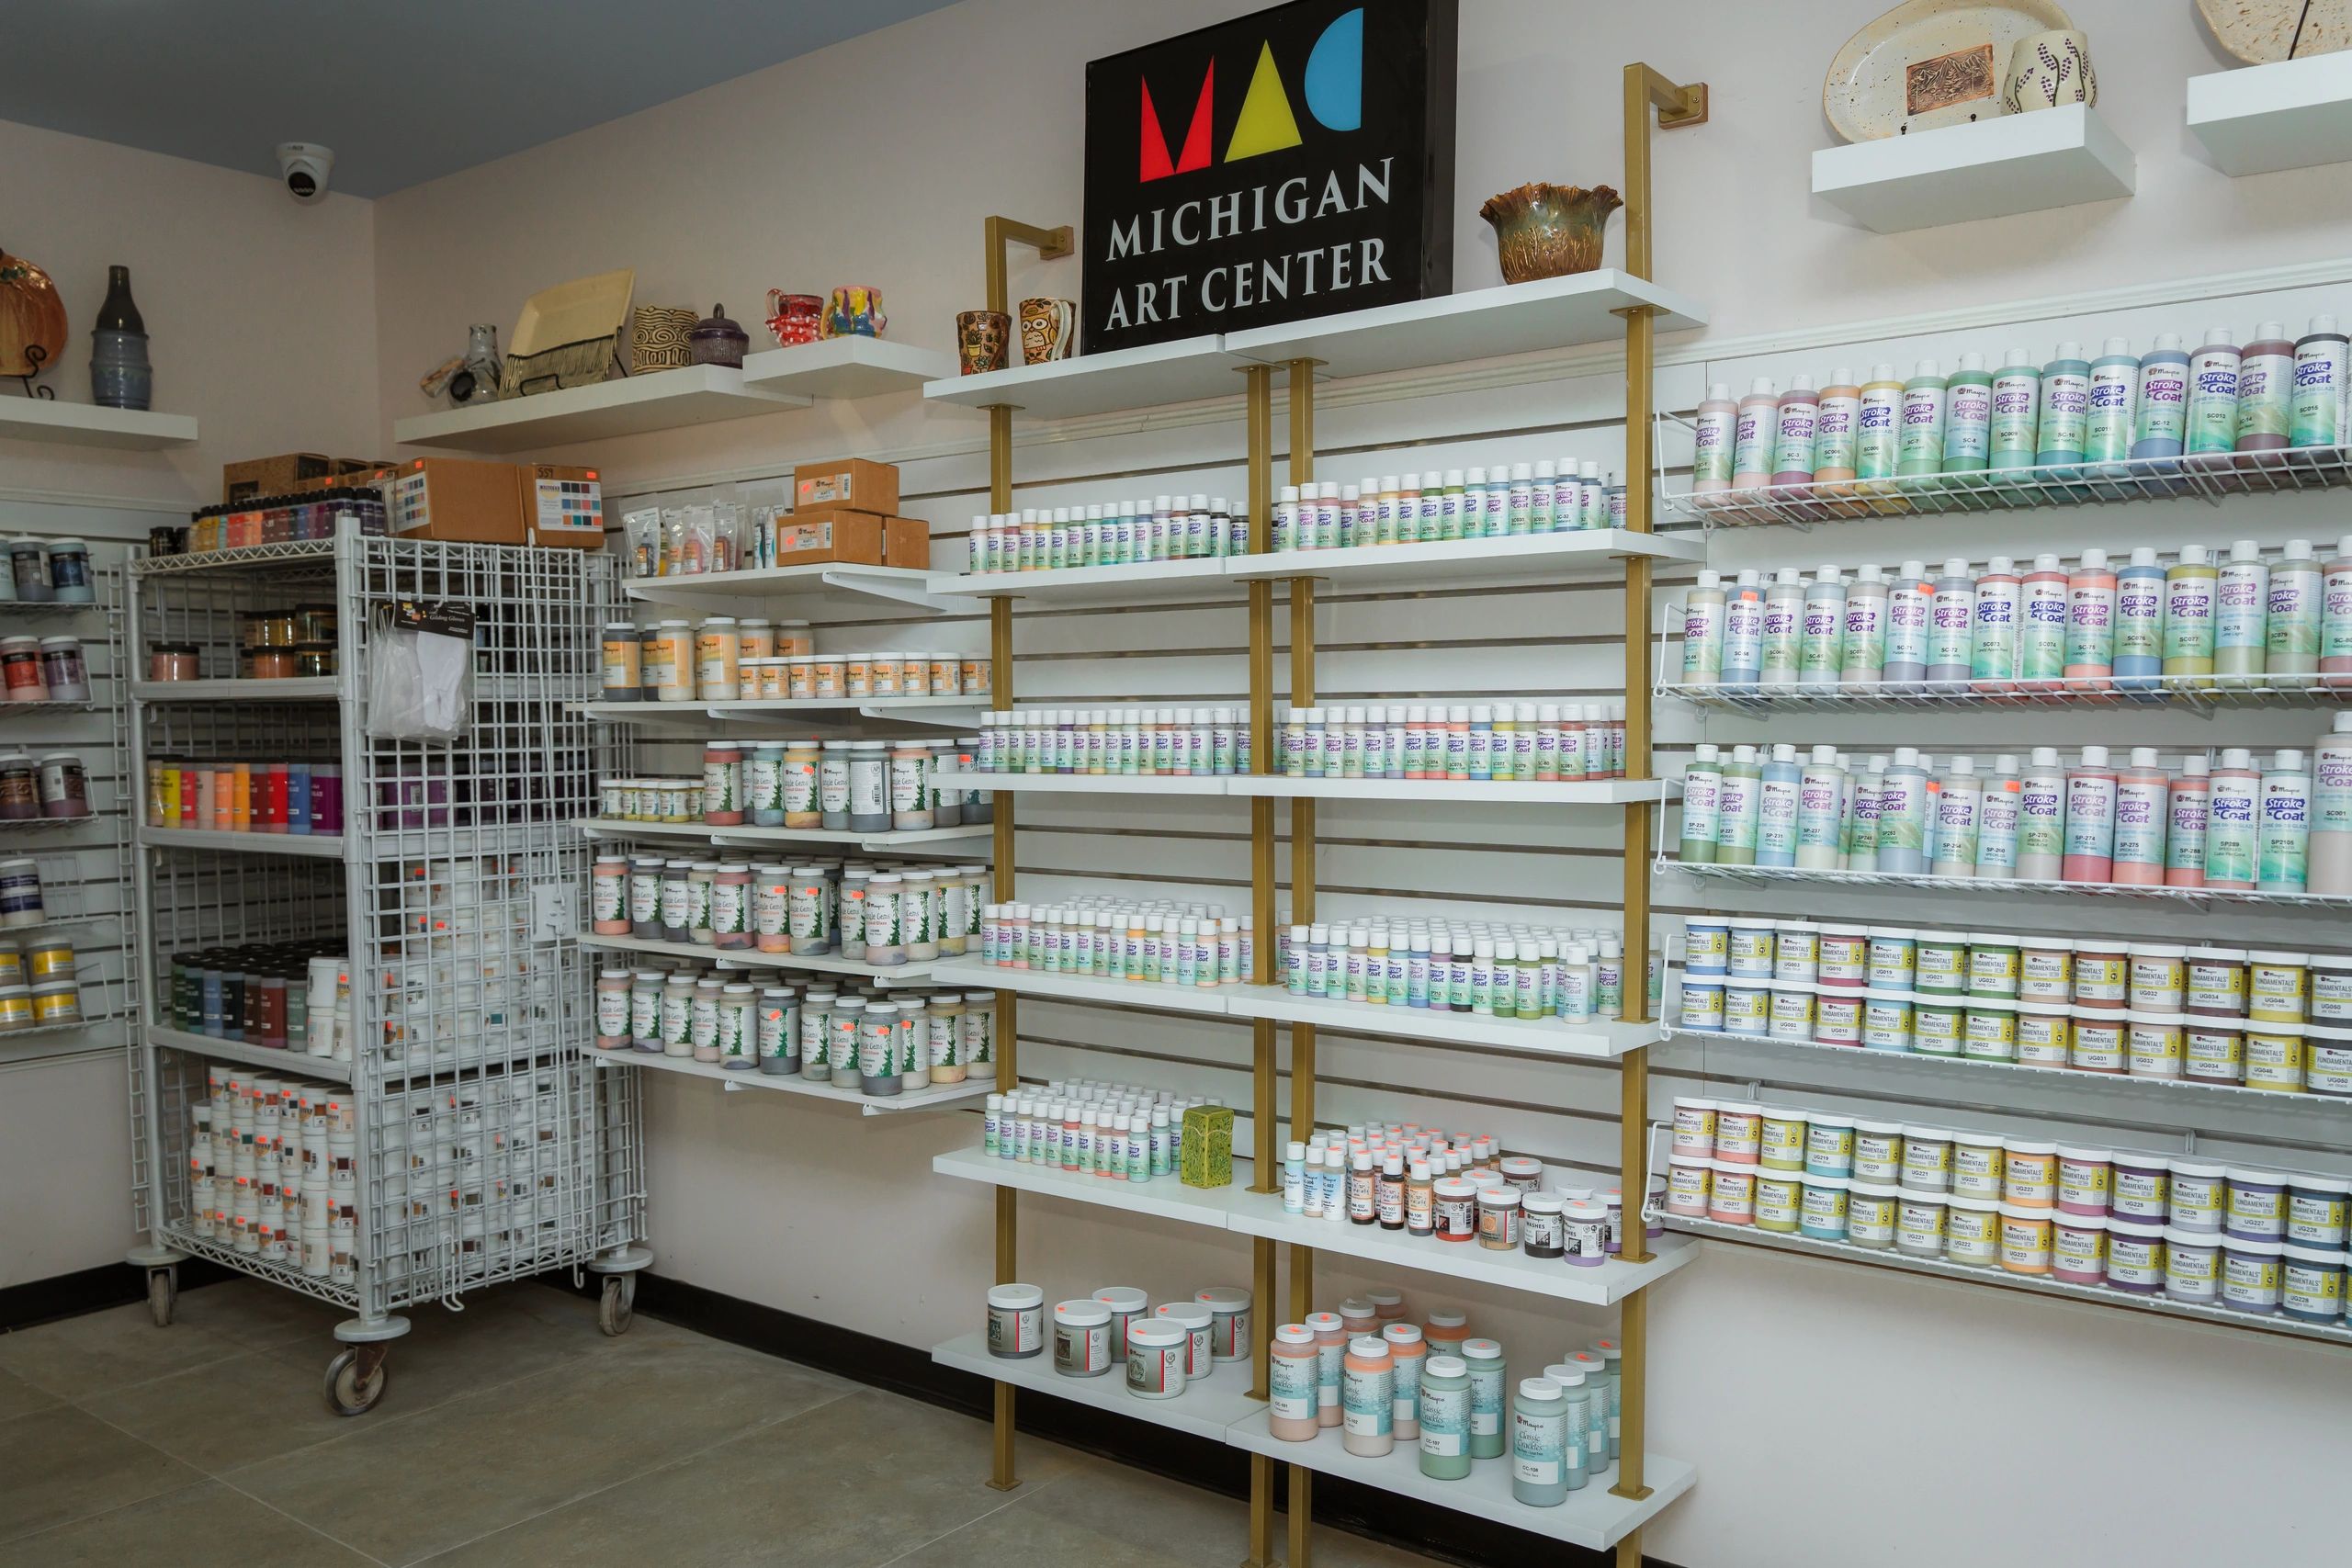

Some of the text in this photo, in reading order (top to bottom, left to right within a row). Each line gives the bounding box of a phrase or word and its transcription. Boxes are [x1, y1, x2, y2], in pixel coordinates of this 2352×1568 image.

[1106, 157, 1394, 262] MICHIGAN
[1104, 238, 1391, 330] ART CENTER
[2296, 363, 2328, 374] Stroke
[2202, 373, 2235, 383] Stroke
[2300, 374, 2331, 387] Coat
[2148, 381, 2181, 390] Stroke
[2208, 383, 2236, 395] Coat
[2053, 392, 2086, 401] Stroke
[2092, 386, 2122, 397] Stroke
[2154, 391, 2182, 402] Coat
[1996, 393, 2028, 402] Stroke
[2096, 397, 2124, 407] Coat
[1957, 400, 1987, 410] Stroke
[2001, 403, 2029, 413] Coat
[2060, 404, 2085, 414] Coat
[1861, 408, 1888, 417] Stroke
[1962, 412, 1987, 422] Coat
[1784, 419, 1811, 427] Stroke
[1864, 418, 1890, 427] Coat
[1907, 414, 1933, 424] Coat
[1788, 428, 1813, 438] Coat
[2221, 585, 2253, 594] Stroke
[2123, 596, 2154, 606] Stroke
[2174, 597, 2206, 606] Stroke
[2225, 596, 2256, 606] Coat
[1893, 607, 1924, 616] Stroke
[1980, 603, 2008, 612] Stroke
[2033, 602, 2064, 611] Stroke
[2074, 605, 2107, 615] Stroke
[1936, 609, 1966, 618] Stroke
[2127, 606, 2156, 618] Coat
[2178, 607, 2209, 618] Coat
[1732, 615, 1758, 625] Stroke
[1898, 615, 1925, 627] Coat
[1983, 612, 2010, 623] Coat
[2039, 612, 2065, 623] Coat
[2079, 615, 2108, 626] Coat
[1940, 618, 1968, 628] Coat
[1735, 626, 1759, 636] Coat
[1804, 790, 1830, 799] Stroke
[2024, 795, 2055, 804] Stroke
[1764, 798, 1792, 807] Stroke
[1806, 799, 1831, 810] Coat
[2073, 795, 2104, 805] Stroke
[2215, 799, 2249, 808] Stroke
[2267, 799, 2302, 808] Stroke
[1940, 806, 1971, 814] Stroke
[2029, 806, 2057, 816] Coat
[2118, 802, 2146, 811] Stroke
[1768, 808, 1792, 818] Coat
[1985, 809, 2015, 818] Stroke
[2077, 807, 2106, 817] Coat
[2221, 810, 2251, 821] Coat
[2274, 810, 2305, 821] Coat
[1945, 816, 1971, 826] Coat
[2121, 813, 2149, 823] Coat
[1989, 819, 2016, 830] Coat
[1520, 1431, 1540, 1442] Classic
[1518, 1439, 1543, 1450] Crackles
